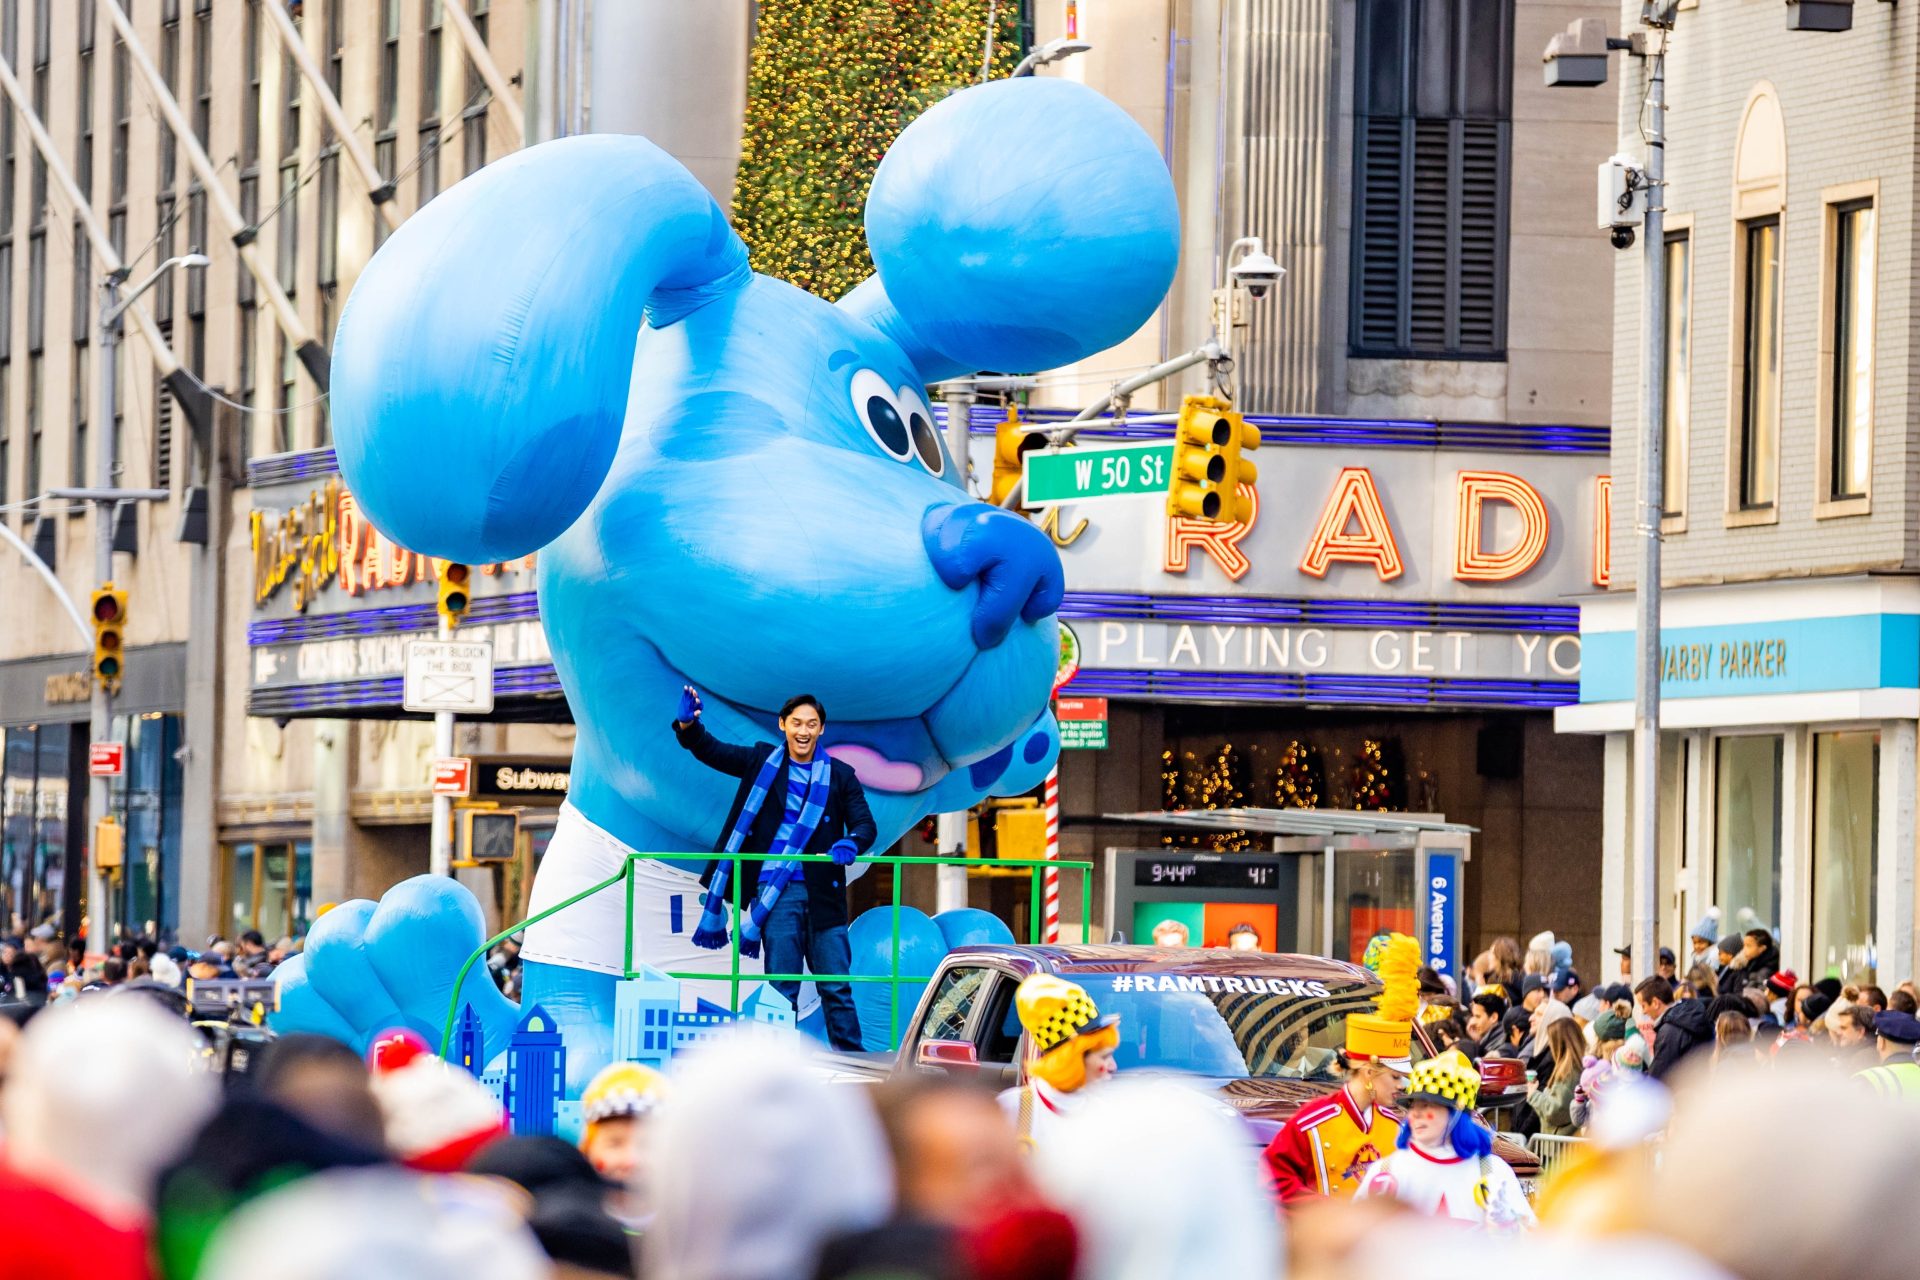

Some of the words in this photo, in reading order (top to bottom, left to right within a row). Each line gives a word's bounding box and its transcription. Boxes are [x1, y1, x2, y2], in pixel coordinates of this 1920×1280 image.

[1075, 458, 1093, 491] W
[1101, 456, 1130, 489] 50
[1139, 454, 1164, 486] St
[449, 647, 486, 658] BLOCK
[1099, 620, 1328, 668] PLAYING
[1369, 629, 1472, 672] GET
[1515, 634, 1581, 676] YO
[1719, 639, 1787, 679] PARKER
[427, 661, 446, 672] THE
[451, 661, 472, 673] BOX
[496, 766, 570, 793] Subway
[1431, 876, 1448, 889] 6
[1430, 891, 1448, 955] Avenue
[1430, 957, 1447, 971] &
[1111, 975, 1331, 998] #RAMTRUCKS
